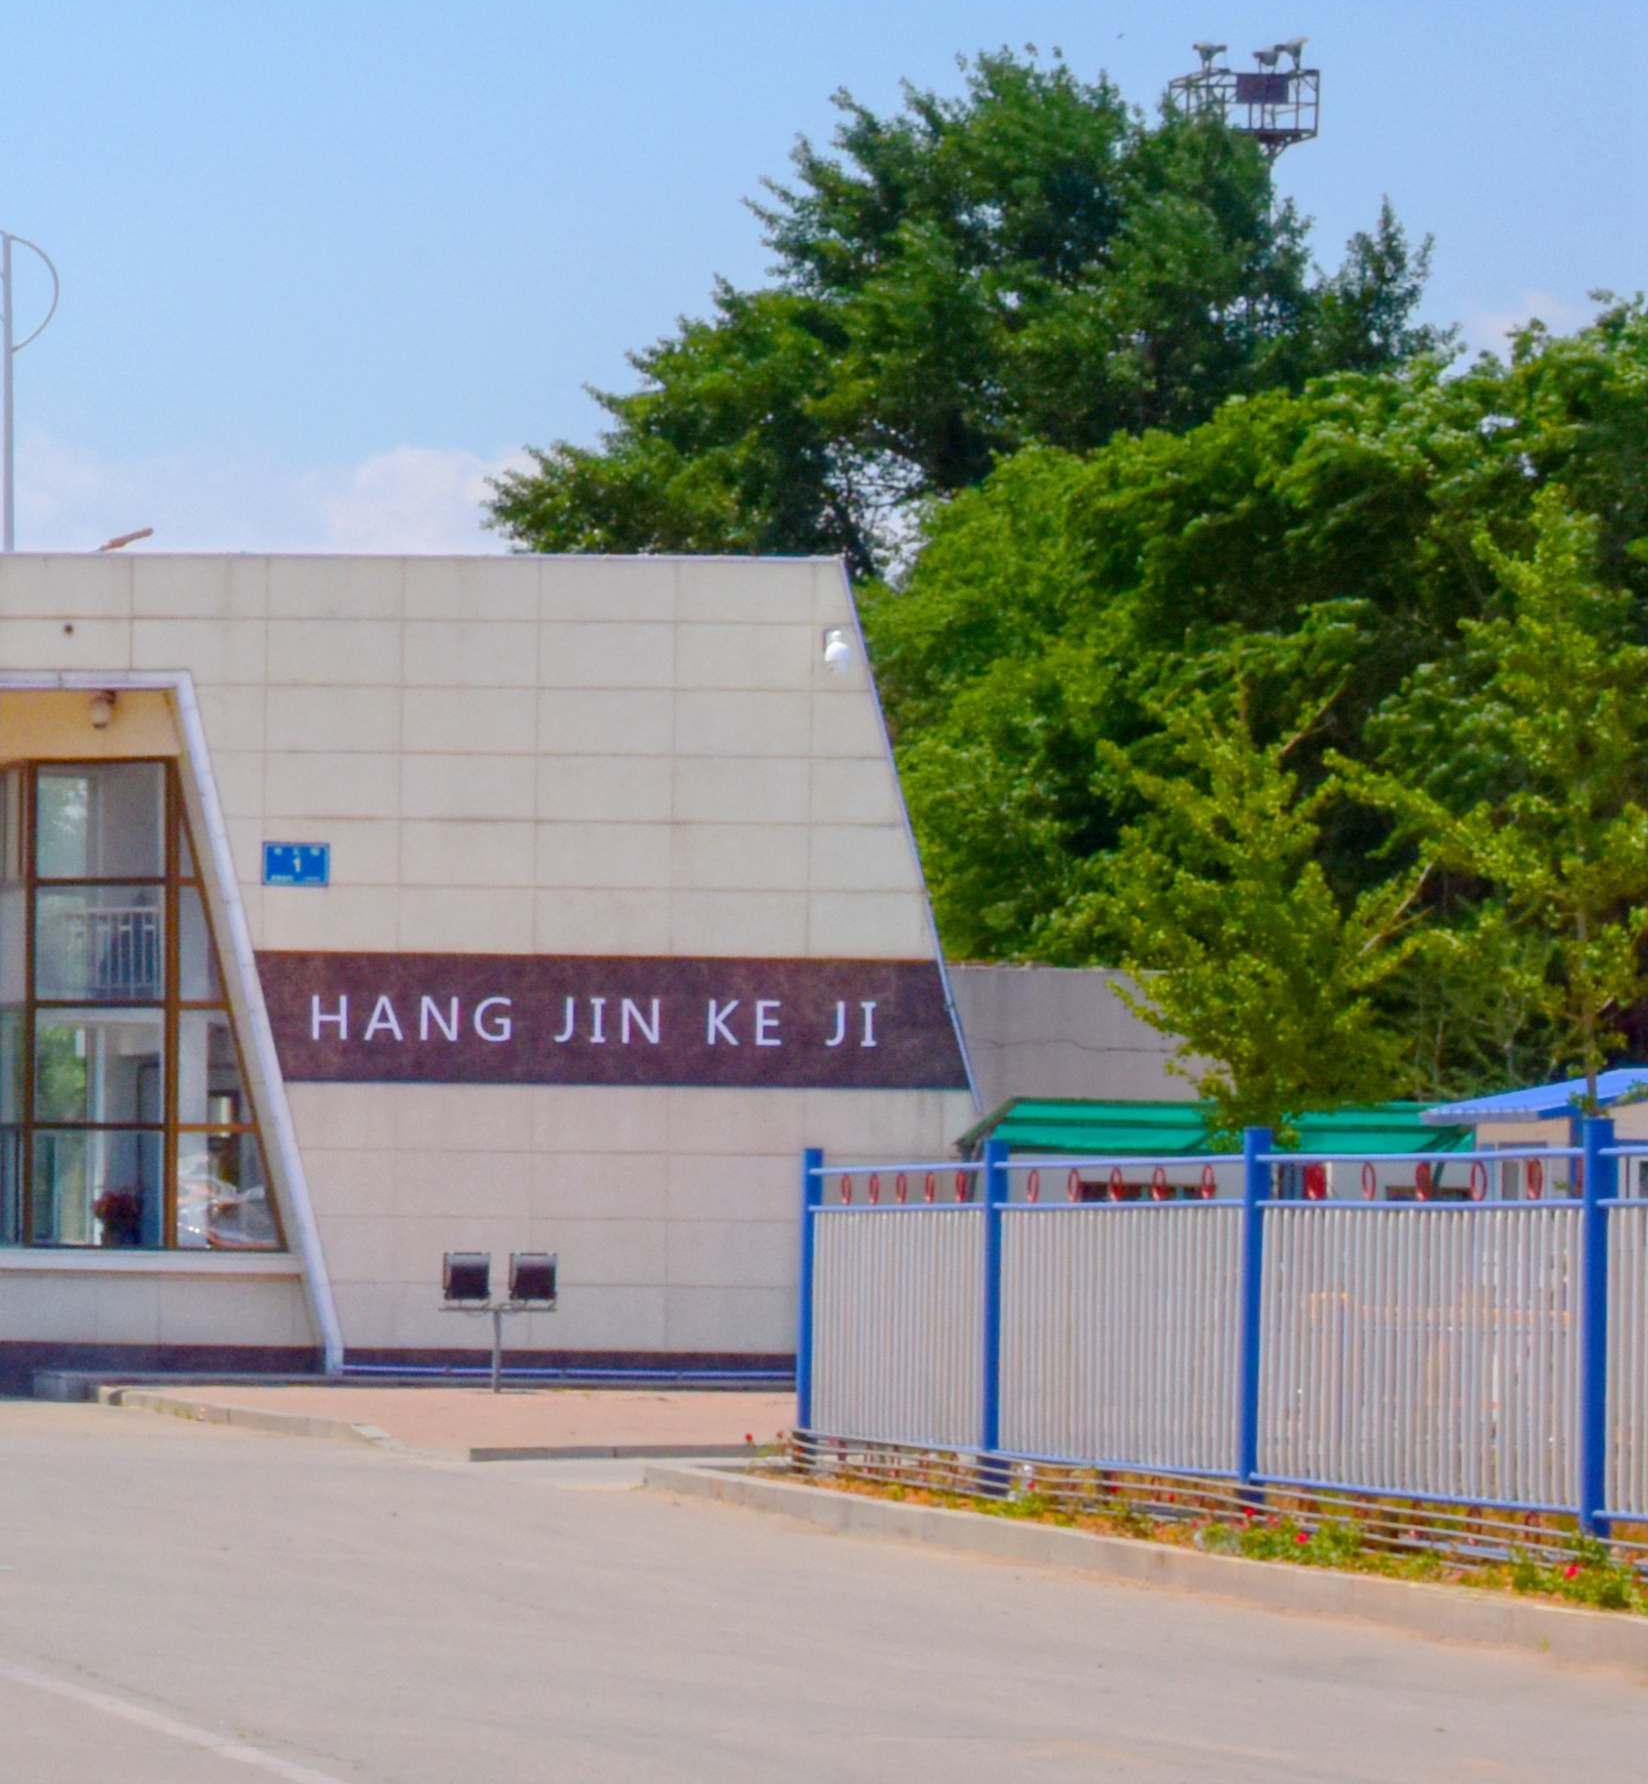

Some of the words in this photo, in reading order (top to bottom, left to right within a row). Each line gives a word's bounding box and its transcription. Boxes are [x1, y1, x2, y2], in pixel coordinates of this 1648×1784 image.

[311, 994, 512, 1042] HANG
[554, 996, 660, 1044] JIN
[707, 999, 782, 1046] KE
[825, 1000, 877, 1047] JI
